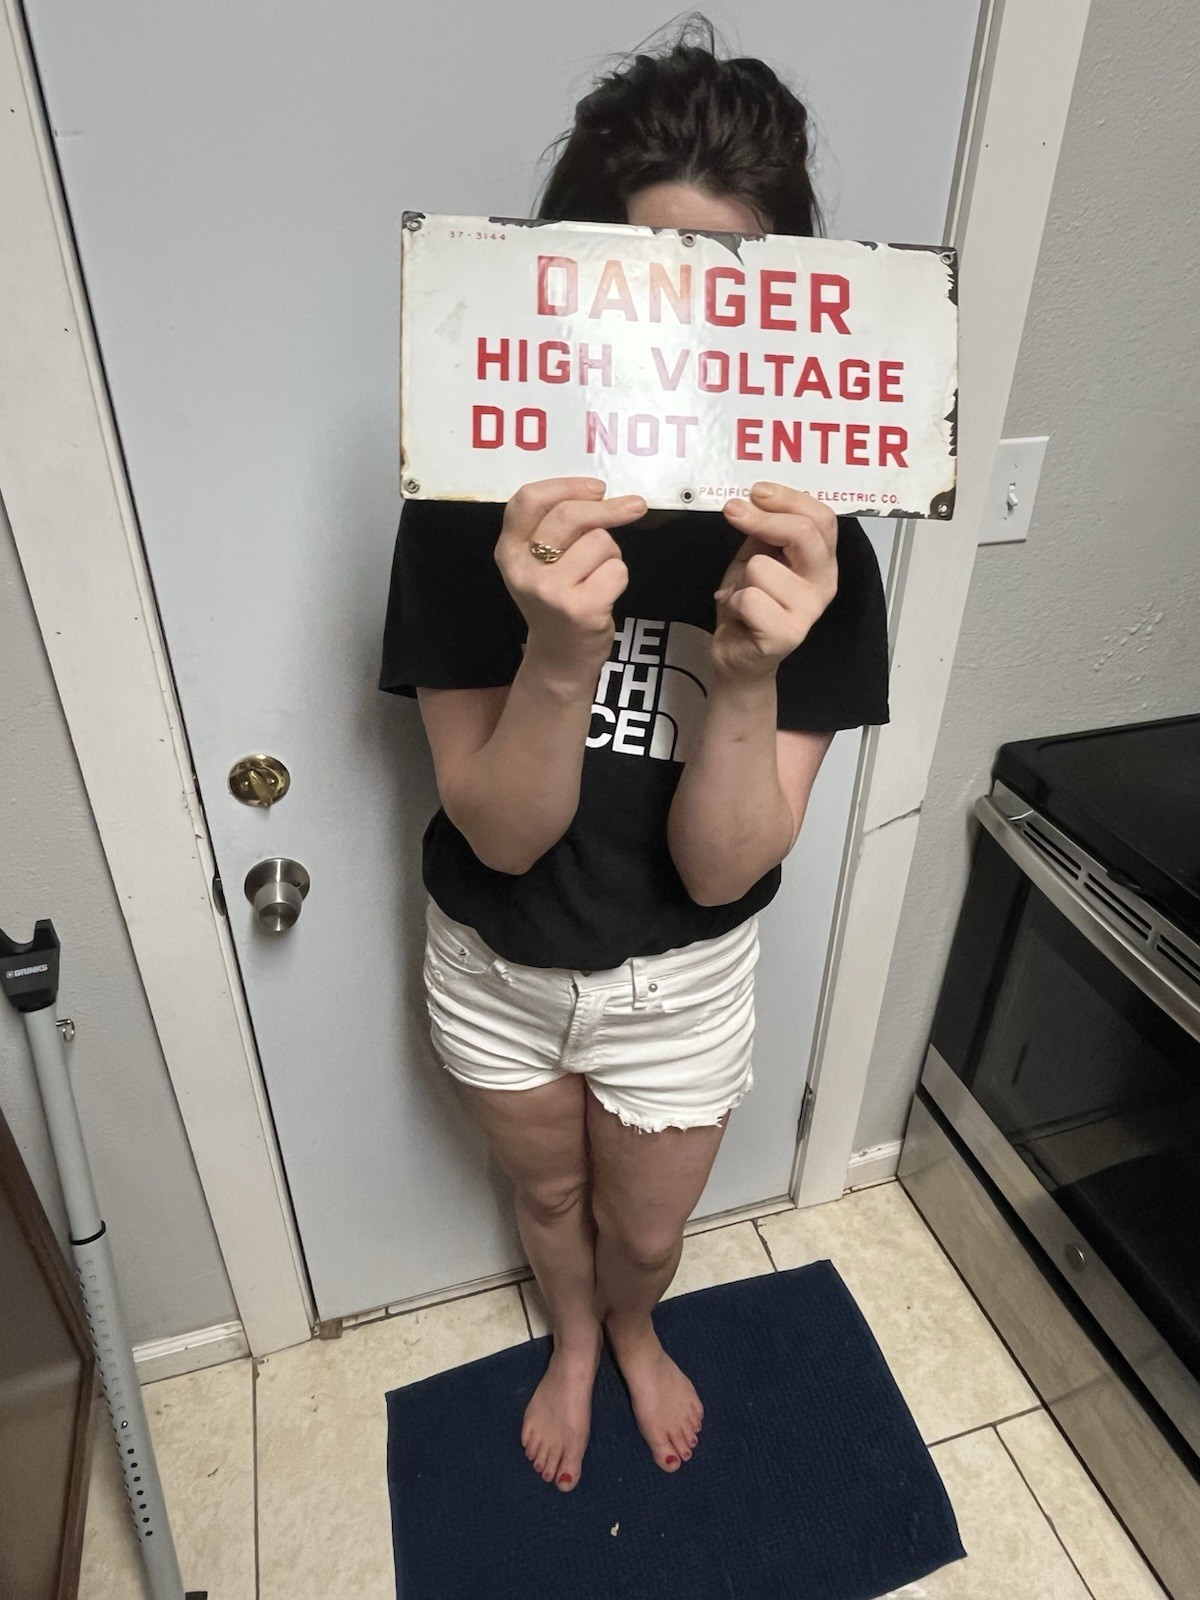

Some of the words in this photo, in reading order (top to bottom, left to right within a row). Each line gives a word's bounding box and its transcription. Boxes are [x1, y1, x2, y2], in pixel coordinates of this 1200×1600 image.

[537, 255, 850, 334] DANGER
[477, 337, 612, 387] HIGH
[651, 347, 904, 402] VOLTAGE
[472, 405, 547, 450] DO
[586, 411, 699, 458] NOT
[736, 418, 909, 468] ENTER
[699, 486, 750, 499] PACIFIC
[818, 491, 876, 503] ELECTRIC
[881, 495, 900, 504] CO.
[614, 616, 666, 664] HE
[585, 704, 651, 756] CE
